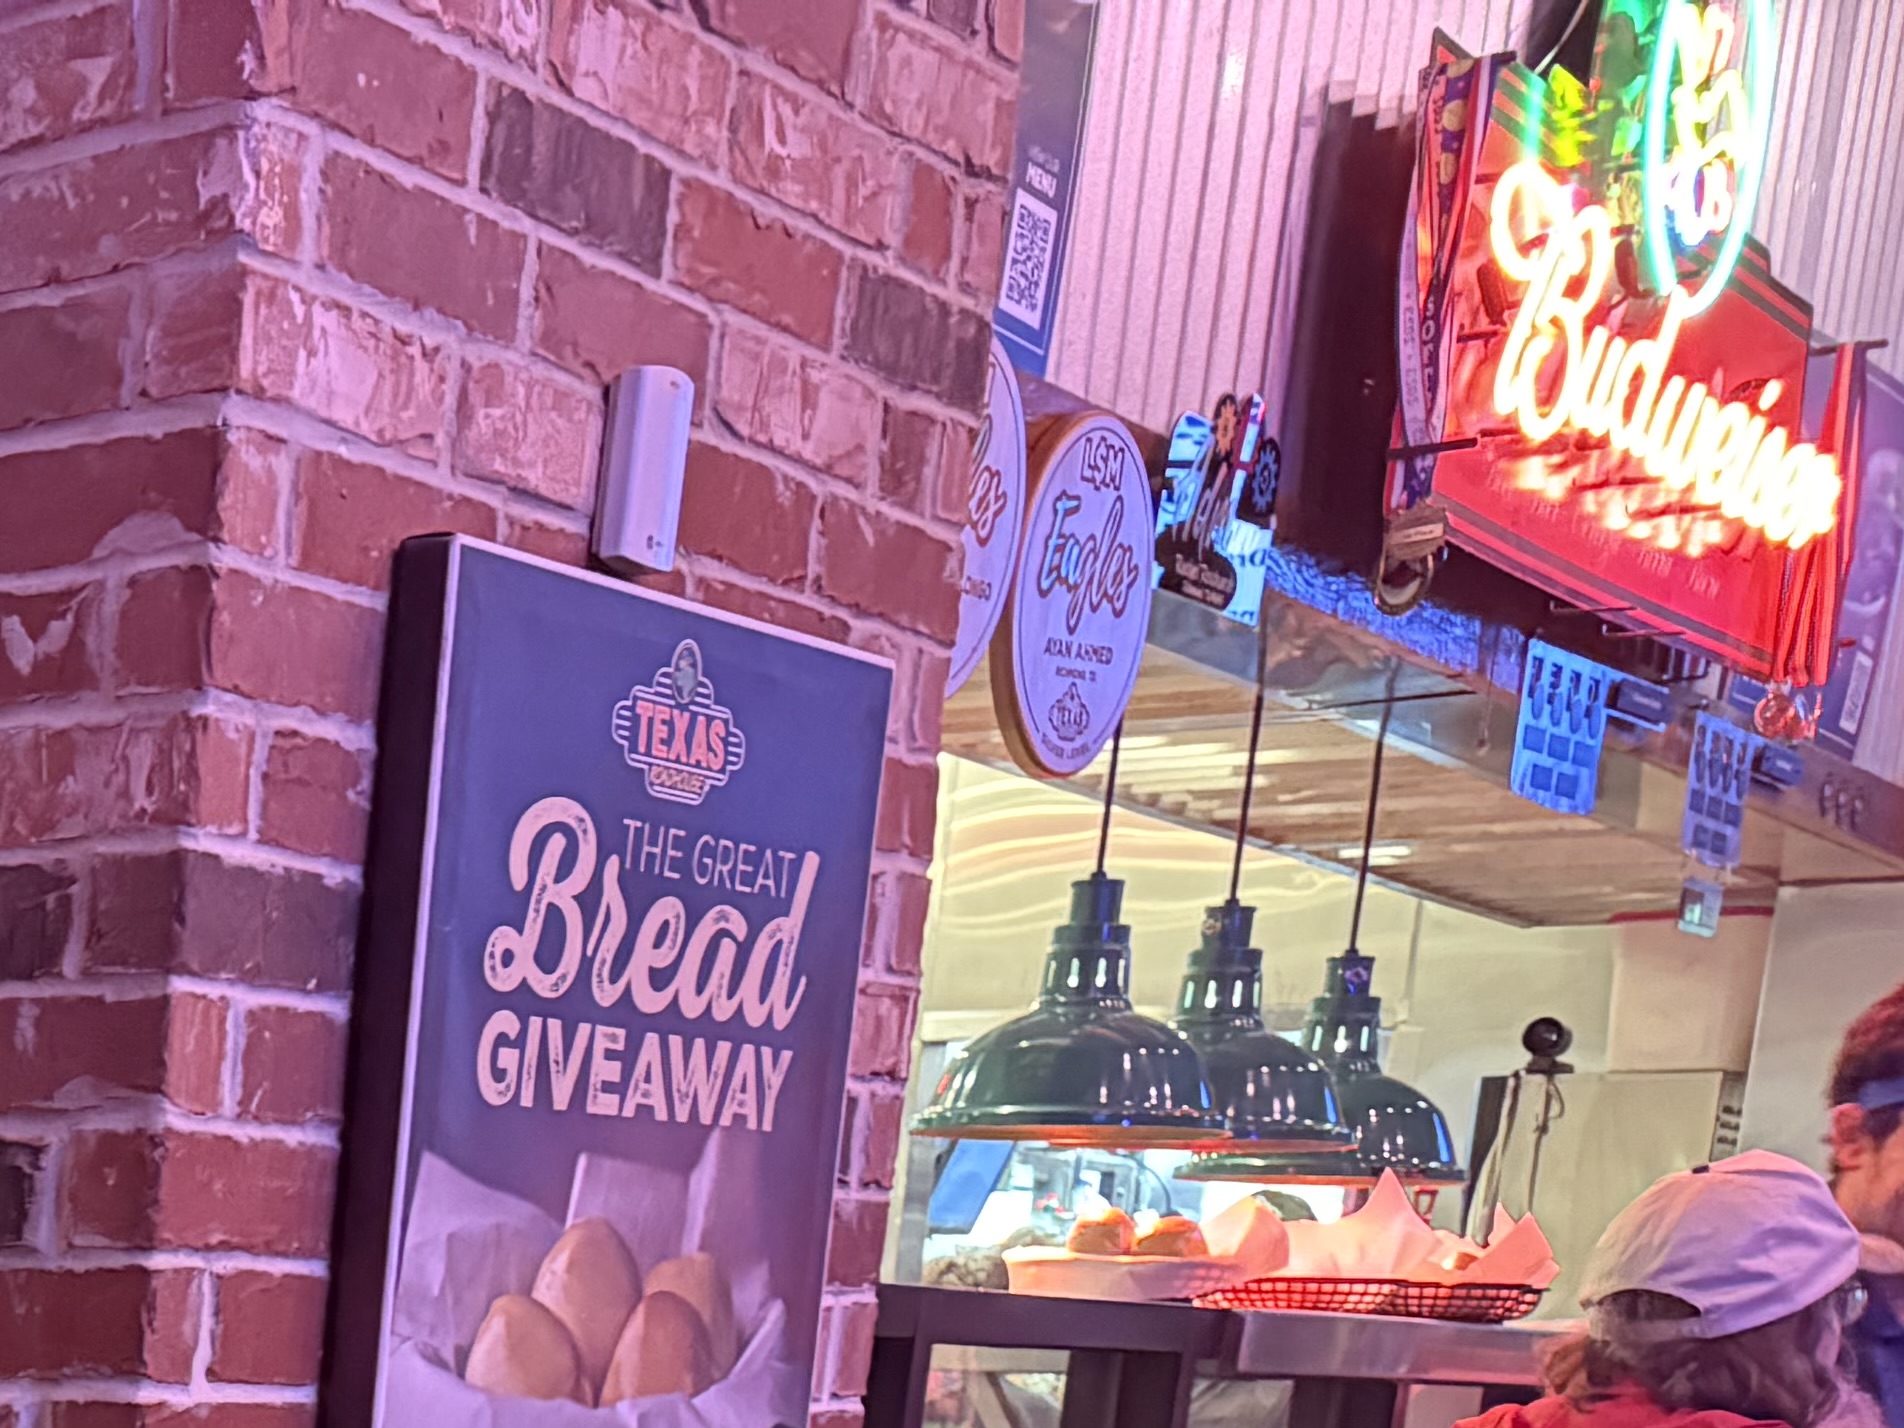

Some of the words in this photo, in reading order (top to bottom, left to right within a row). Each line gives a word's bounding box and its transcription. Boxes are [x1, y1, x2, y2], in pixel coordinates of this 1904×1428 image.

[1490, 159, 1843, 549] Budweiser
[1038, 490, 1139, 636] Eagles
[635, 701, 728, 772] TEXAS
[483, 796, 821, 1032] Bread
[623, 818, 686, 880] THE
[693, 834, 798, 899] GREAT
[476, 1009, 793, 1132] GIVEAWAY
